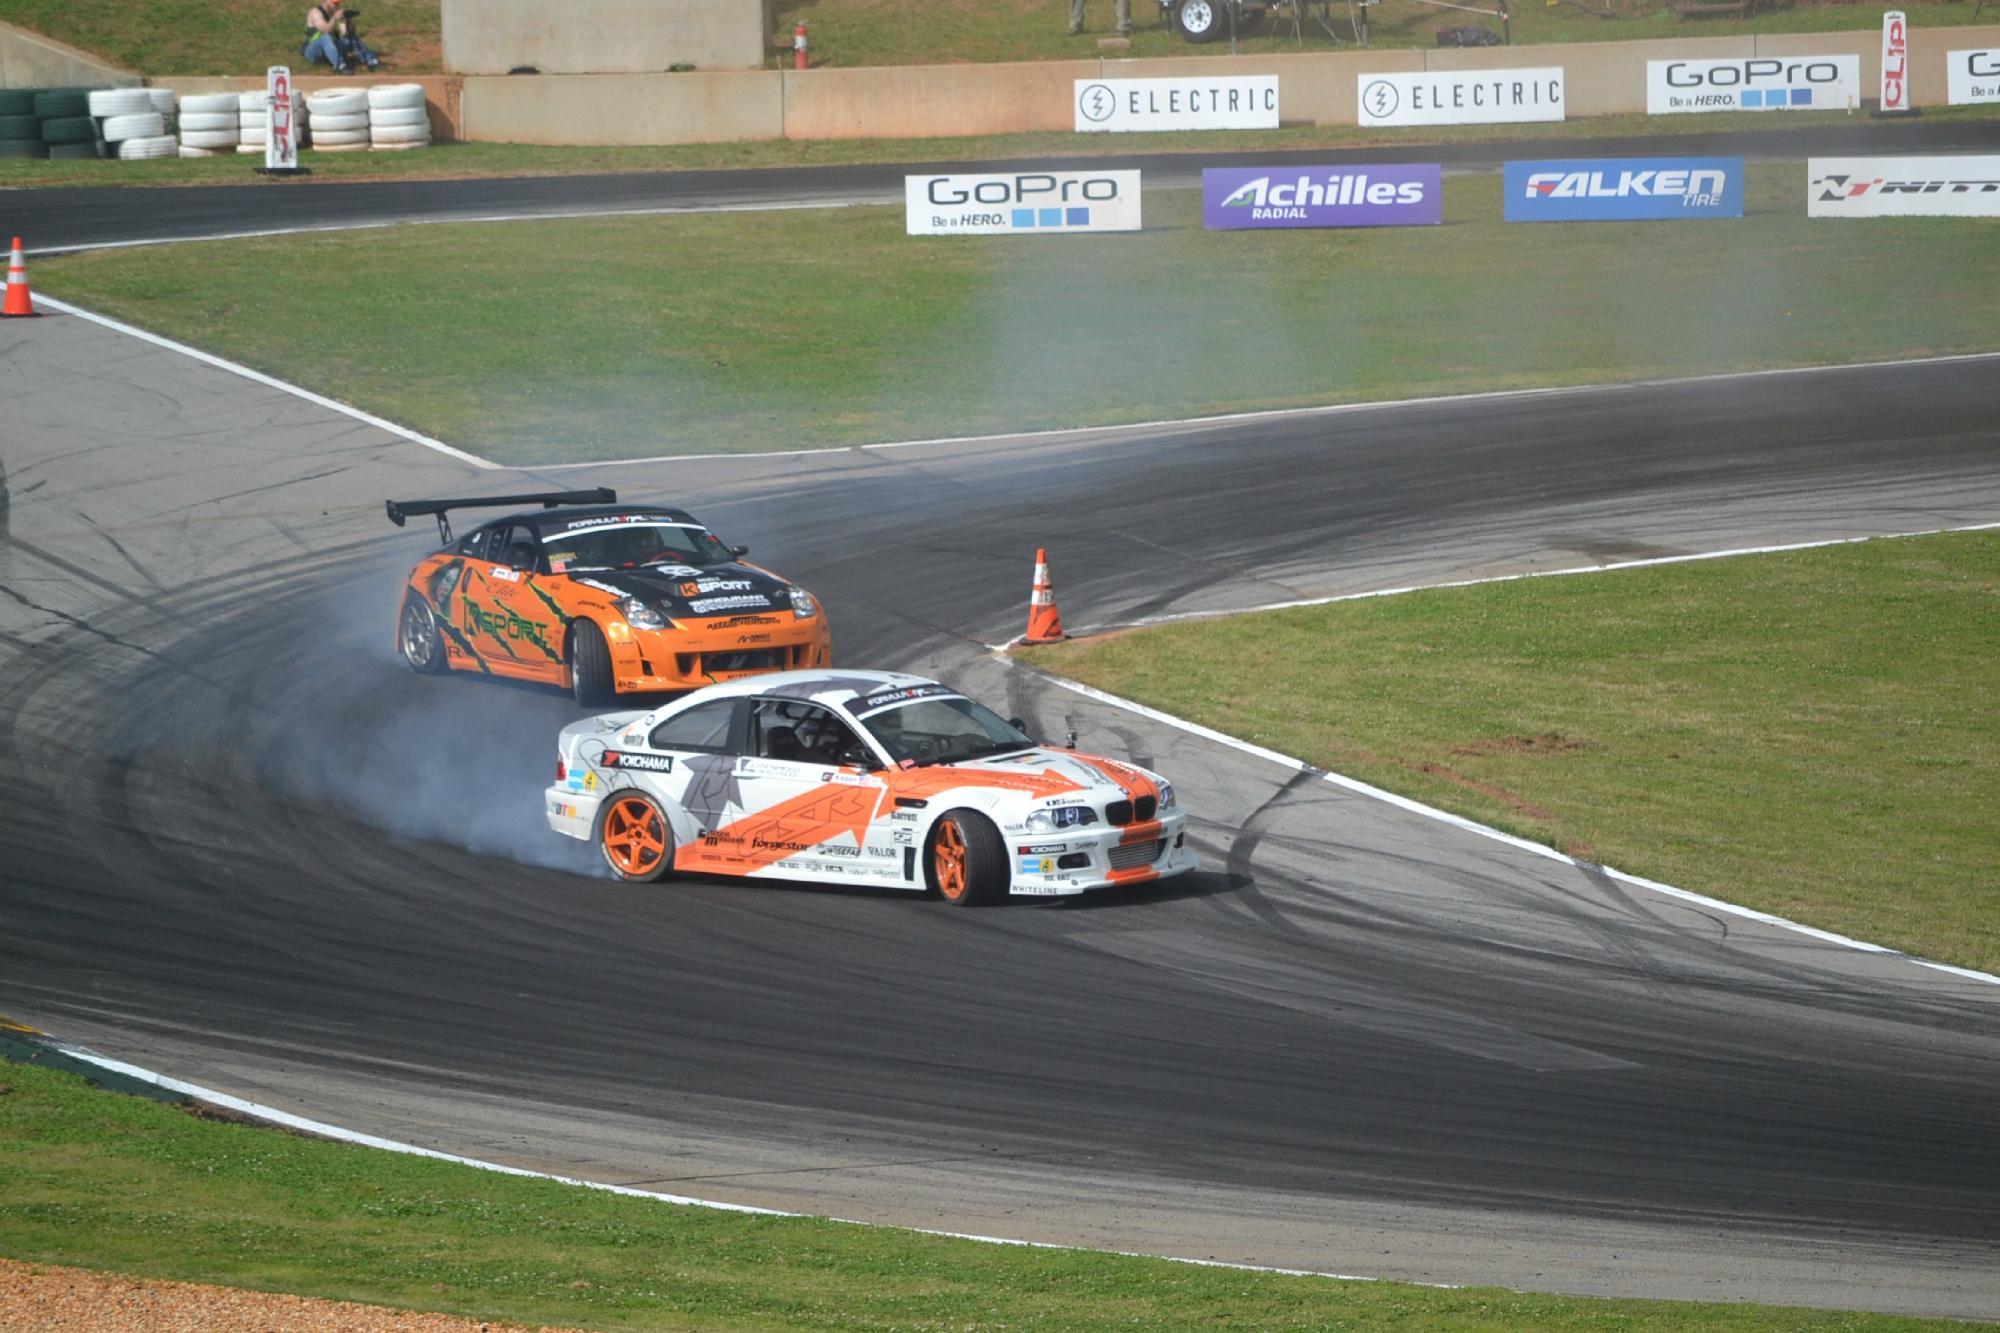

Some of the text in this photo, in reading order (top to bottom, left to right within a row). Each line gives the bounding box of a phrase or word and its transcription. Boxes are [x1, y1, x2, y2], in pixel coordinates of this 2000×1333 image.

[1886, 20, 1905, 108] CLIP
[1666, 60, 1838, 88] GoPro
[1129, 88, 1275, 114] ELECTRIC
[1412, 79, 1559, 110] ELECTRIC
[1694, 95, 1736, 106] HERO.
[928, 175, 1118, 205] GoPro
[1221, 174, 1424, 207] Achilles
[1524, 169, 1726, 198] FALKEN
[1683, 194, 1721, 207] TIRE
[932, 213, 1006, 227] Be a HERO.
[1252, 207, 1308, 220] RADIAL
[619, 755, 670, 771] YOKOHAMA
[867, 846, 897, 857] VALOR
[1030, 845, 1065, 854] YOKOHAMA
[1012, 886, 1058, 895] WHITELINE
